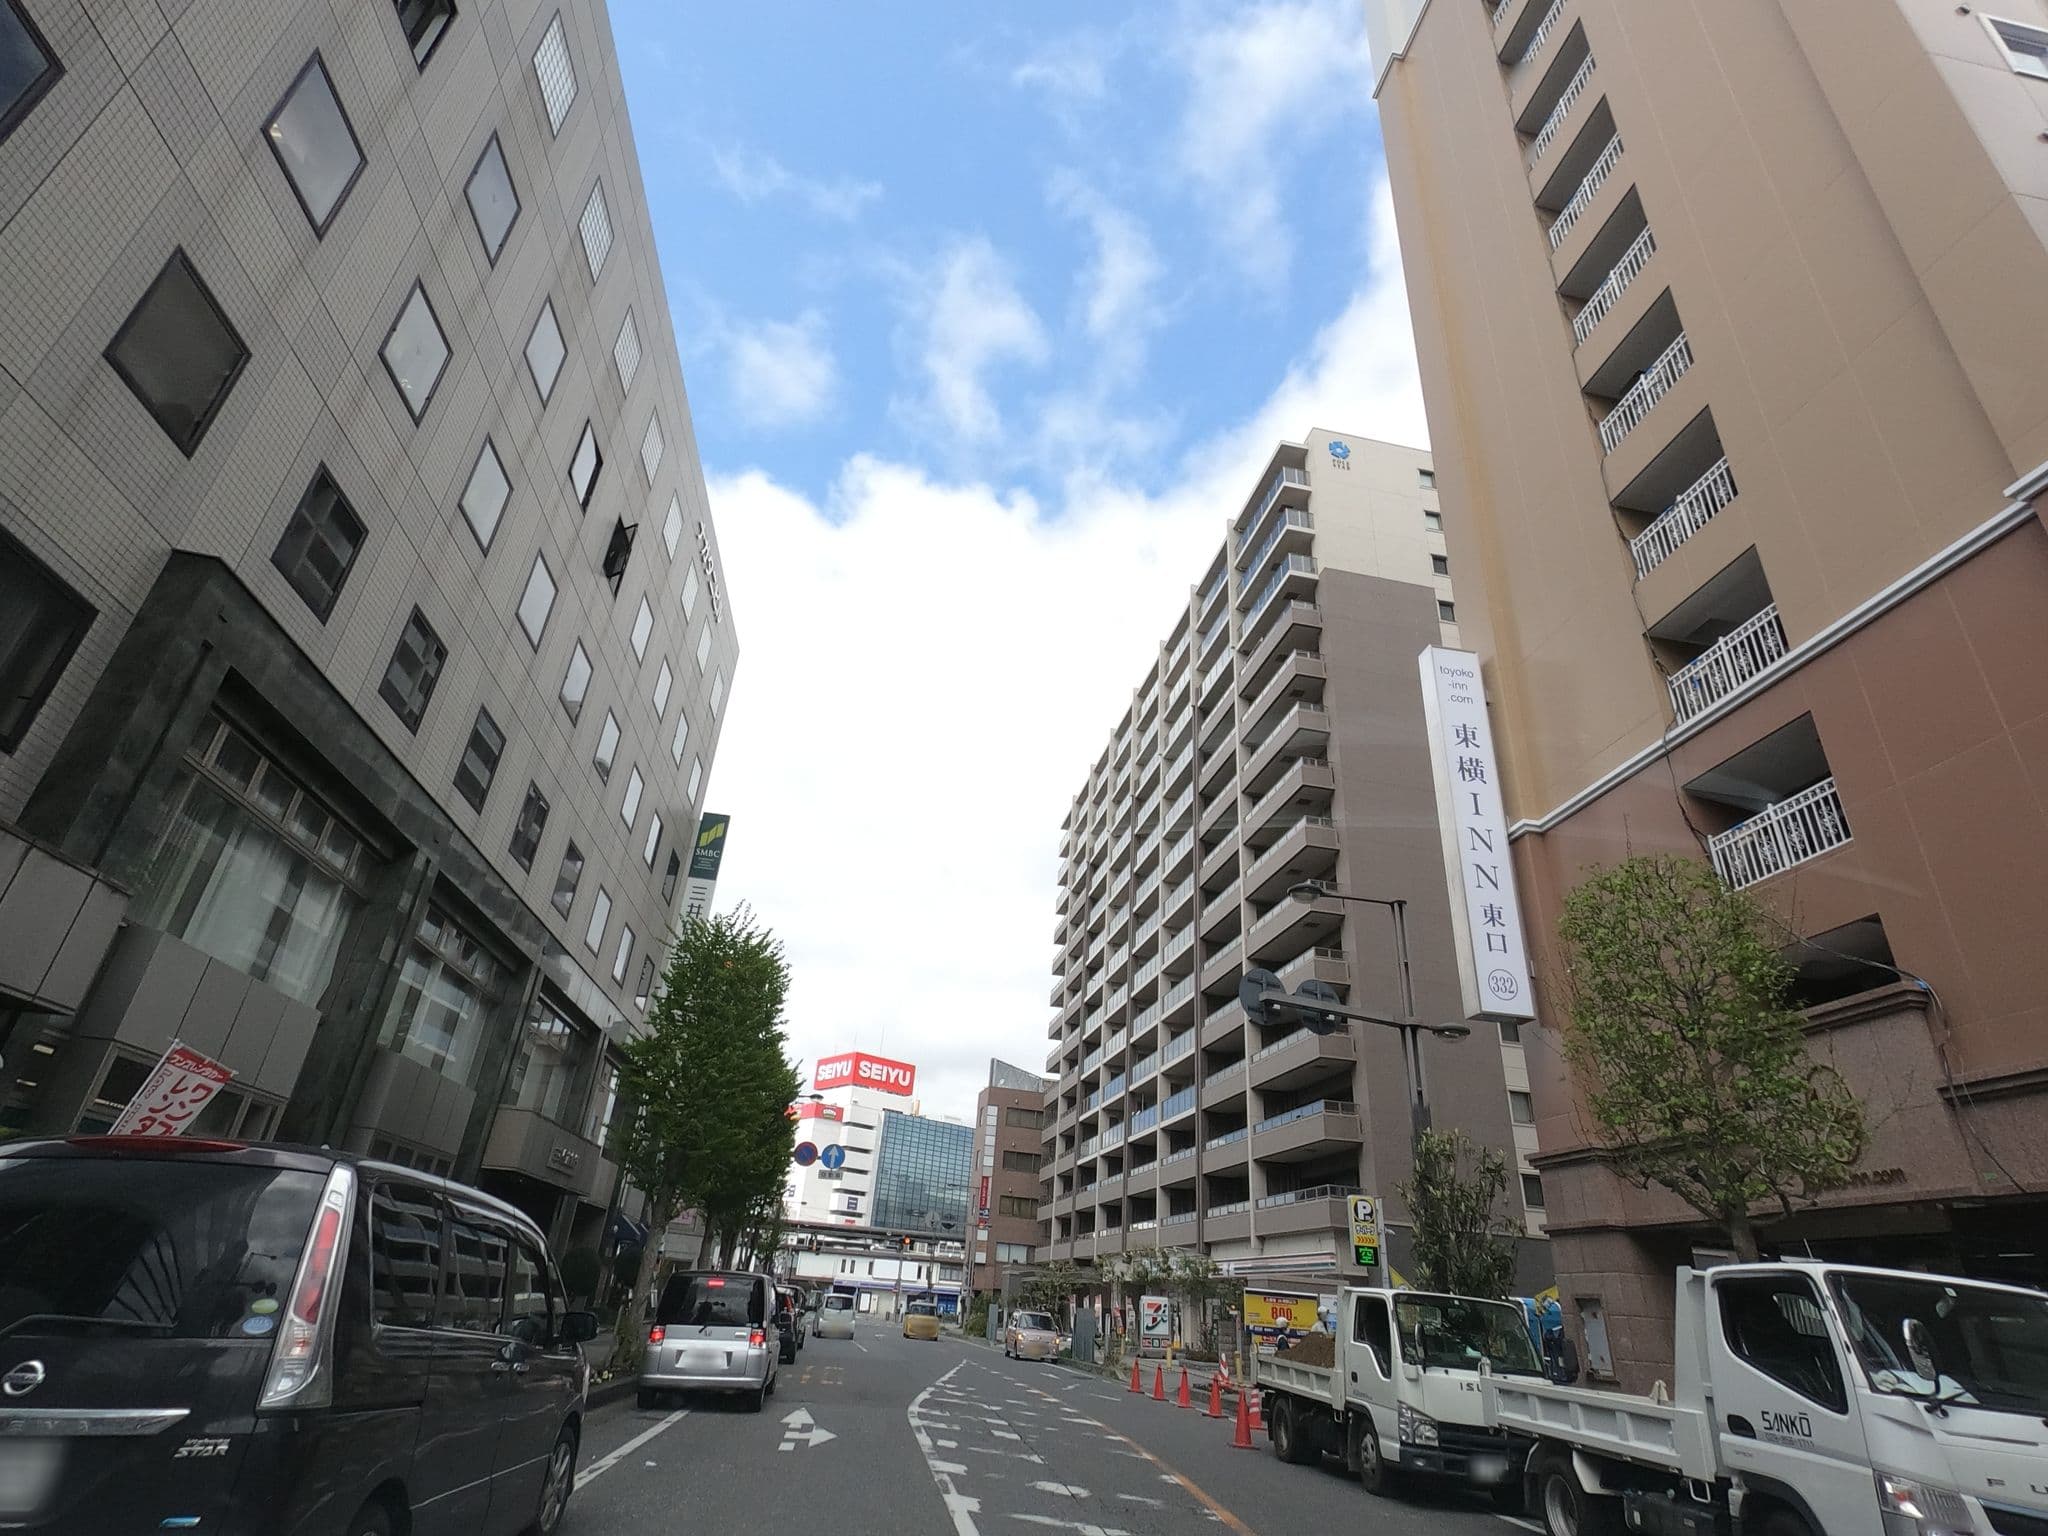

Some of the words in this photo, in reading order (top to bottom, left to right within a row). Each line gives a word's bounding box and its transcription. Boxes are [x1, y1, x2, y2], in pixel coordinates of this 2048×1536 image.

[1440, 666, 1474, 678] toyoko
[1448, 695, 1473, 704] .com
[695, 848, 720, 858] SMBC
[1491, 976, 1516, 994] 332
[817, 1060, 852, 1081] SEIYU
[858, 1060, 911, 1087] SEIYU
[1357, 1200, 1372, 1220] P
[1359, 1247, 1375, 1264] 空
[1271, 1306, 1293, 1321] 800
[173, 1446, 229, 1457] STAR
